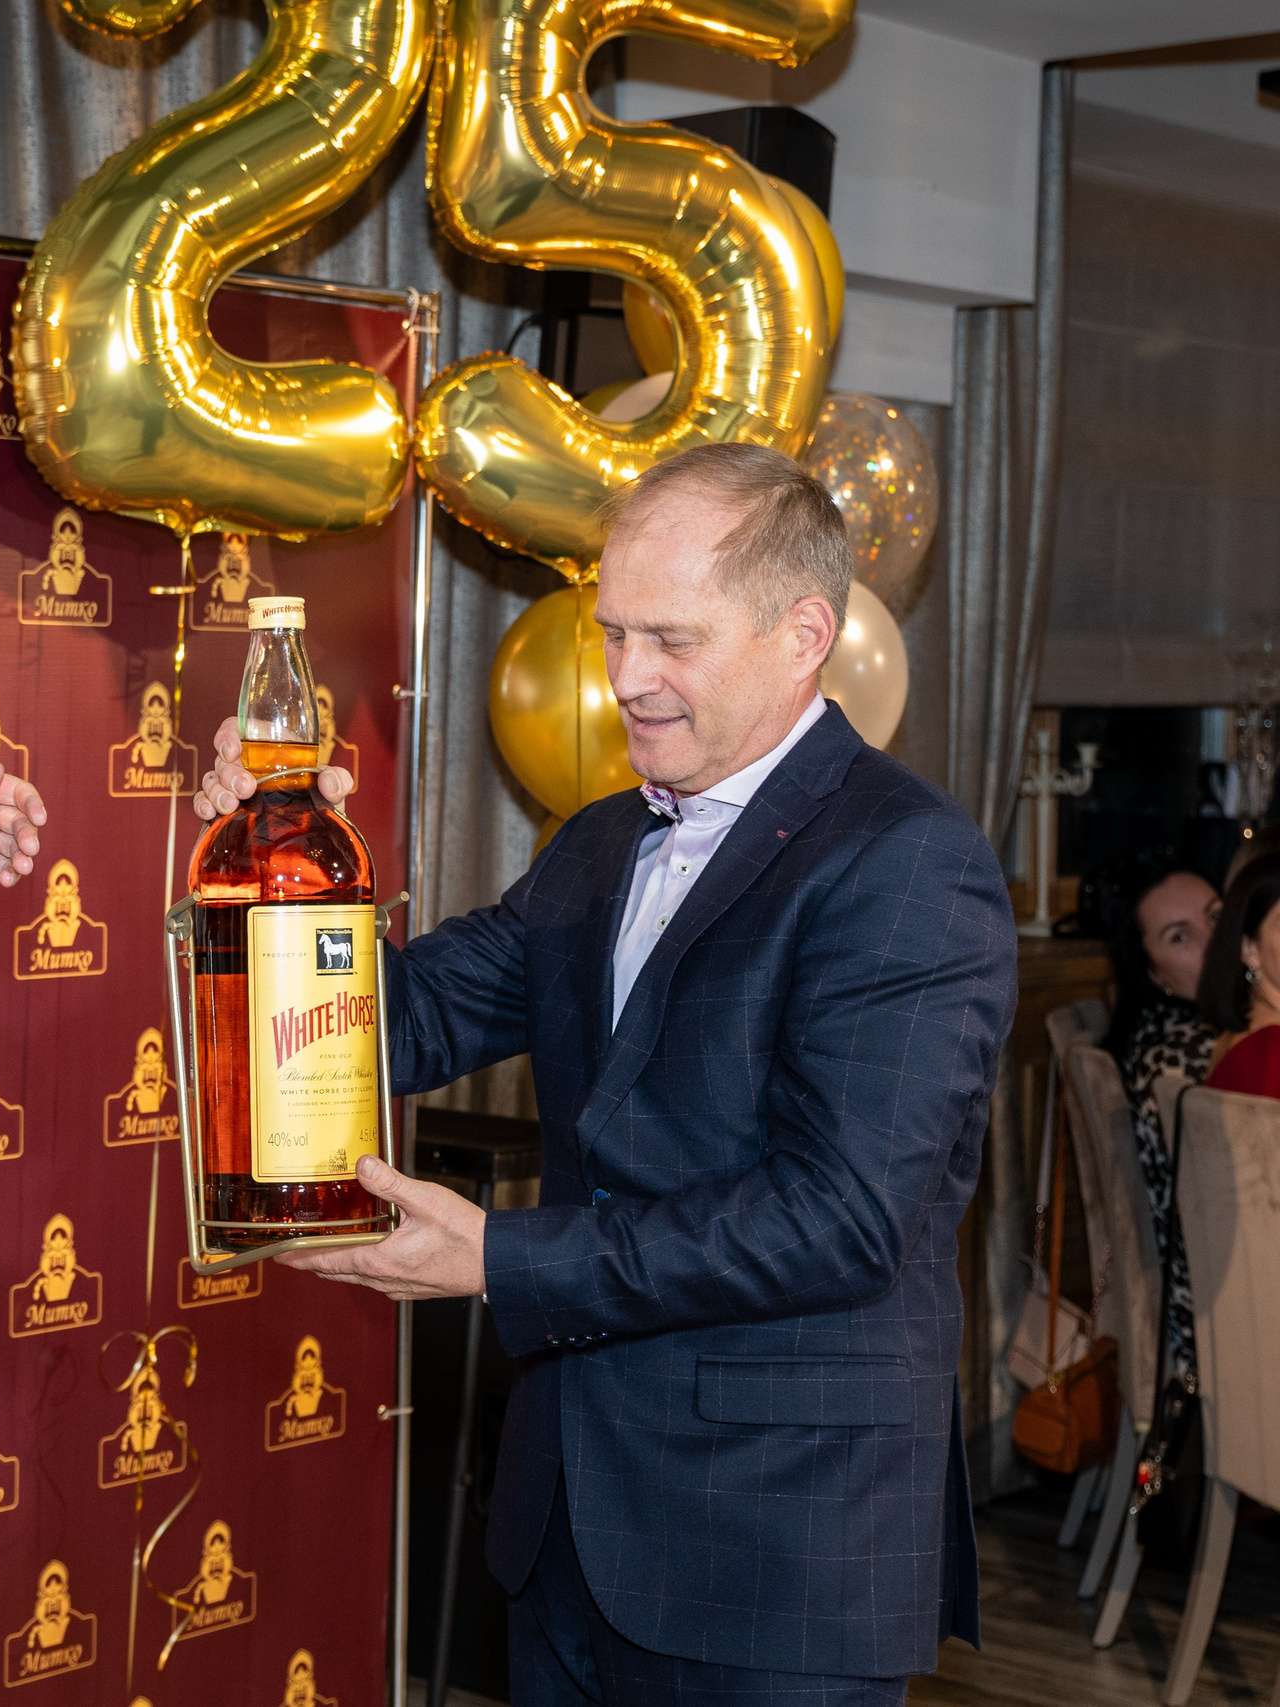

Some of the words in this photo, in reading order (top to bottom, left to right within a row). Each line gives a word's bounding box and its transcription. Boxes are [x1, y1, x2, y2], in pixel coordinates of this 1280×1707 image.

[35, 594, 98, 622] Митко
[204, 602, 249, 625] Мит
[263, 607, 284, 619] WHITE
[30, 948, 93, 972] Митко
[271, 1001, 334, 1069] WHITE
[336, 991, 374, 1036] HORSE
[278, 1067, 326, 1082] Blended
[325, 1068, 353, 1082] Scotch
[342, 1085, 374, 1093] DISTILLERS
[120, 1115, 178, 1139] Митко
[268, 1132, 291, 1147] 40%
[293, 1132, 308, 1146] vol
[192, 1276, 249, 1299] Митко
[24, 1301, 87, 1328] Митко
[278, 1416, 333, 1442] Митко
[20, 1643, 82, 1677] Митко
